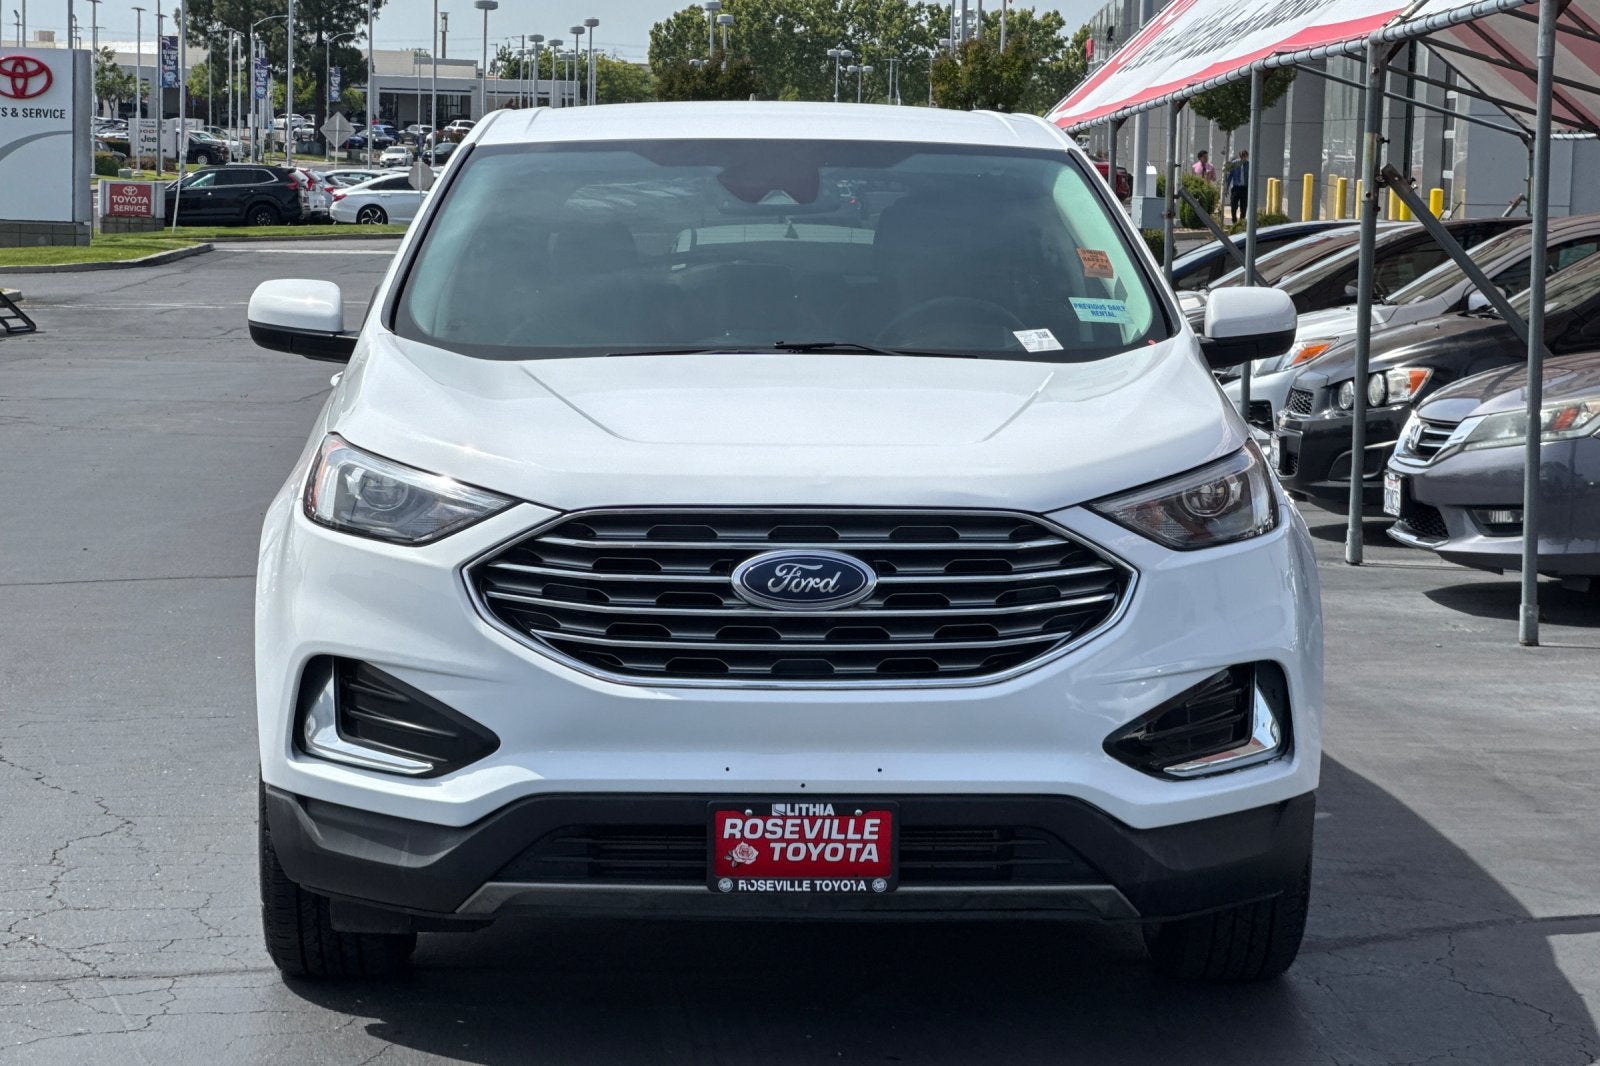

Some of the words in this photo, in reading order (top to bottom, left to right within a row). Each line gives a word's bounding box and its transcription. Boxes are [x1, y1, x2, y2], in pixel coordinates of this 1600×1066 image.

[10, 107, 19, 118] &
[22, 107, 66, 120] SERVICE
[141, 134, 160, 143] Jee
[112, 195, 149, 204] TOYOTA
[113, 204, 147, 212] SERVICE
[1073, 302, 1107, 311] PREVIOUS
[1107, 304, 1126, 312] DAILY
[1091, 310, 1117, 318] RENTAL
[767, 563, 842, 593] Ford
[784, 803, 835, 816] LITHIA
[723, 818, 881, 840] ROSEVILLE
[769, 842, 879, 863] TOYOTA
[738, 880, 811, 891] ROSEVILLE
[814, 880, 867, 891] TOYOTA
